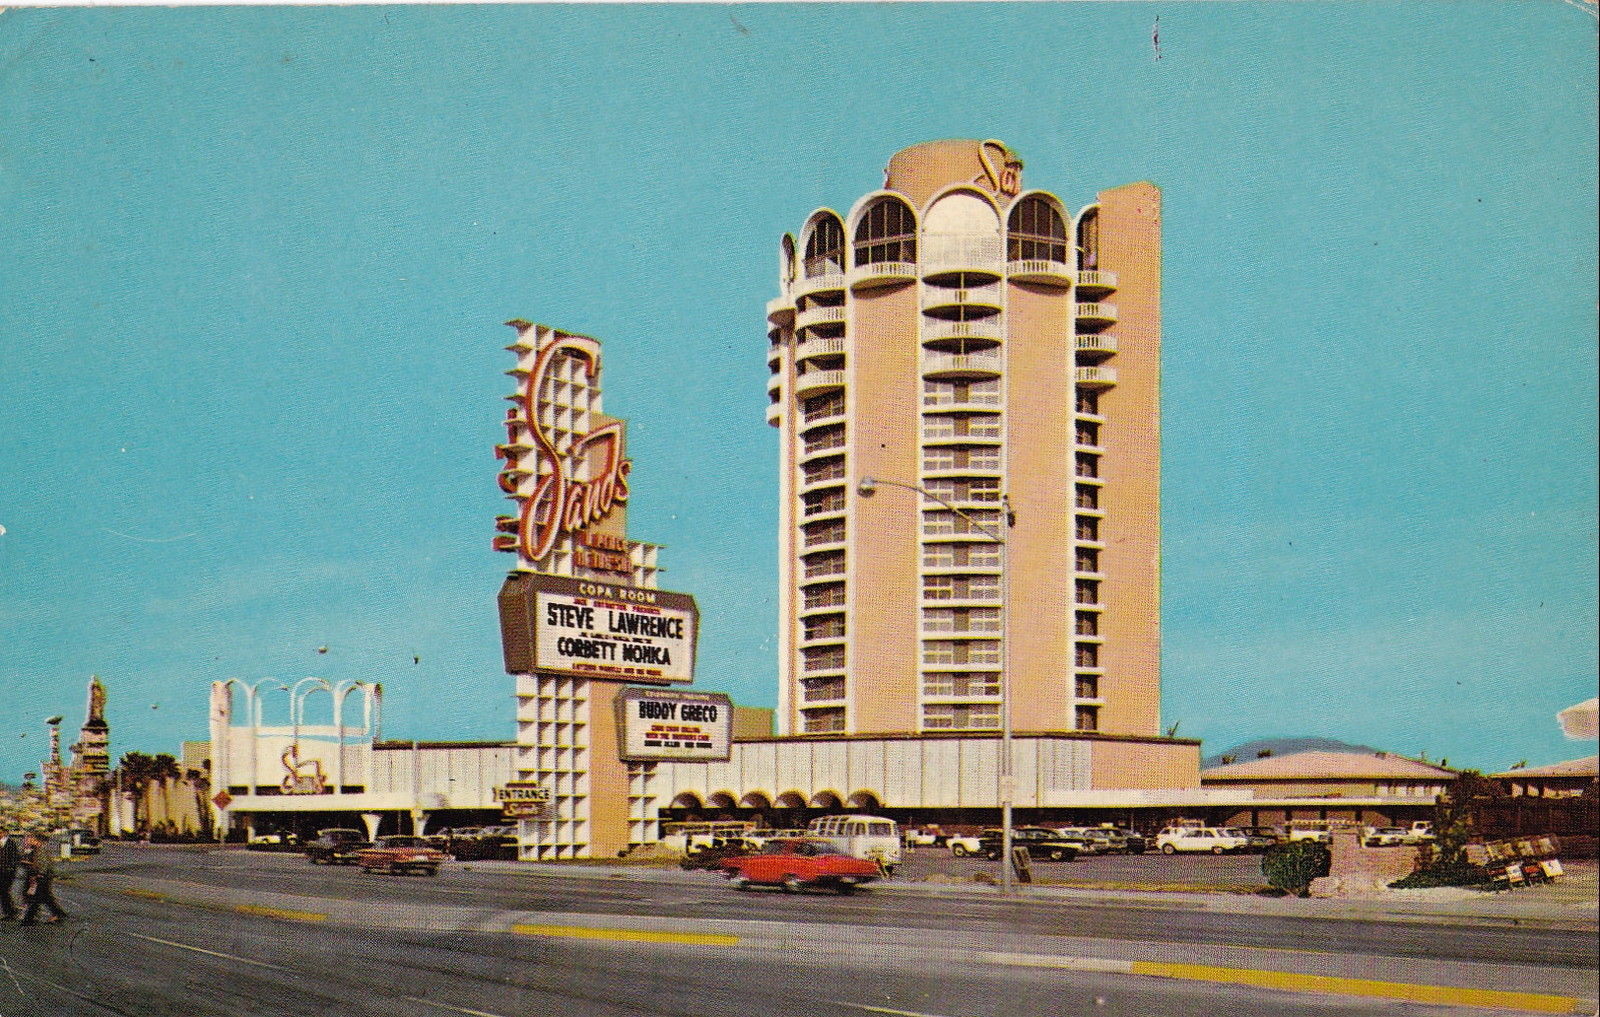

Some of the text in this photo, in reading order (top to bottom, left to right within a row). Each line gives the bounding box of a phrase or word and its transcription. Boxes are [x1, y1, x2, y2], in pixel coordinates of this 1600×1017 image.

[524, 336, 632, 561] Sands
[579, 583, 656, 603] COPA ROOM
[547, 602, 594, 630] STEVE
[608, 611, 683, 640] LAWRENCE
[557, 637, 616, 661] CORBETT
[638, 701, 718, 722] BUDDY GRECO
[499, 789, 549, 799] ENTRANCE
